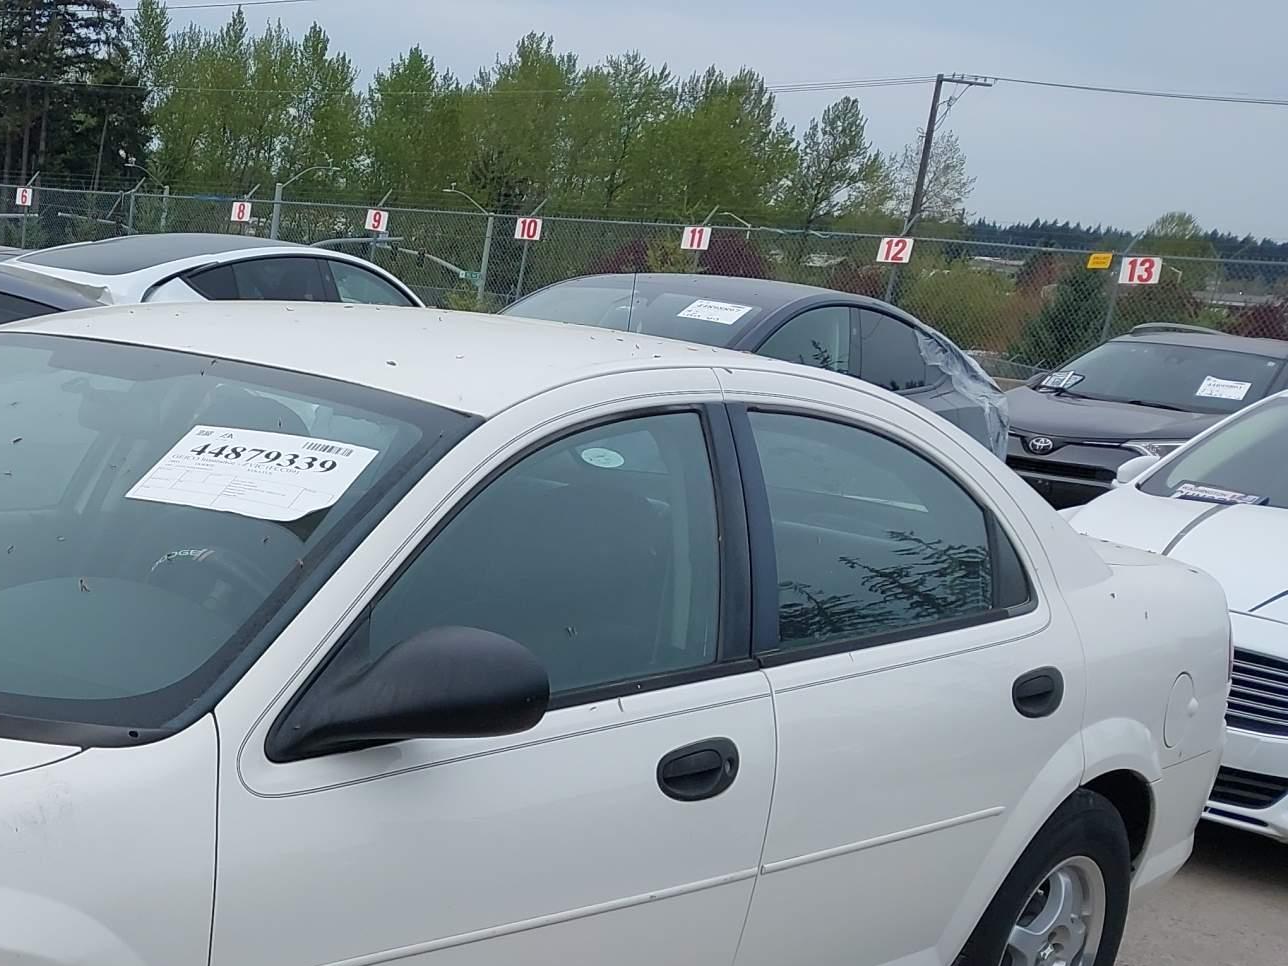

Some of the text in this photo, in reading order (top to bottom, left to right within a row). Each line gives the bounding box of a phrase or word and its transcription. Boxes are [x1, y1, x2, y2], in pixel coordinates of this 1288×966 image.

[21, 189, 28, 204] 6
[237, 203, 246, 220] 8
[372, 211, 382, 229] 9
[520, 218, 538, 239] 10
[690, 228, 704, 249] 11
[884, 239, 907, 262] 12
[1128, 258, 1155, 283] 13
[190, 443, 338, 474] 44879339
